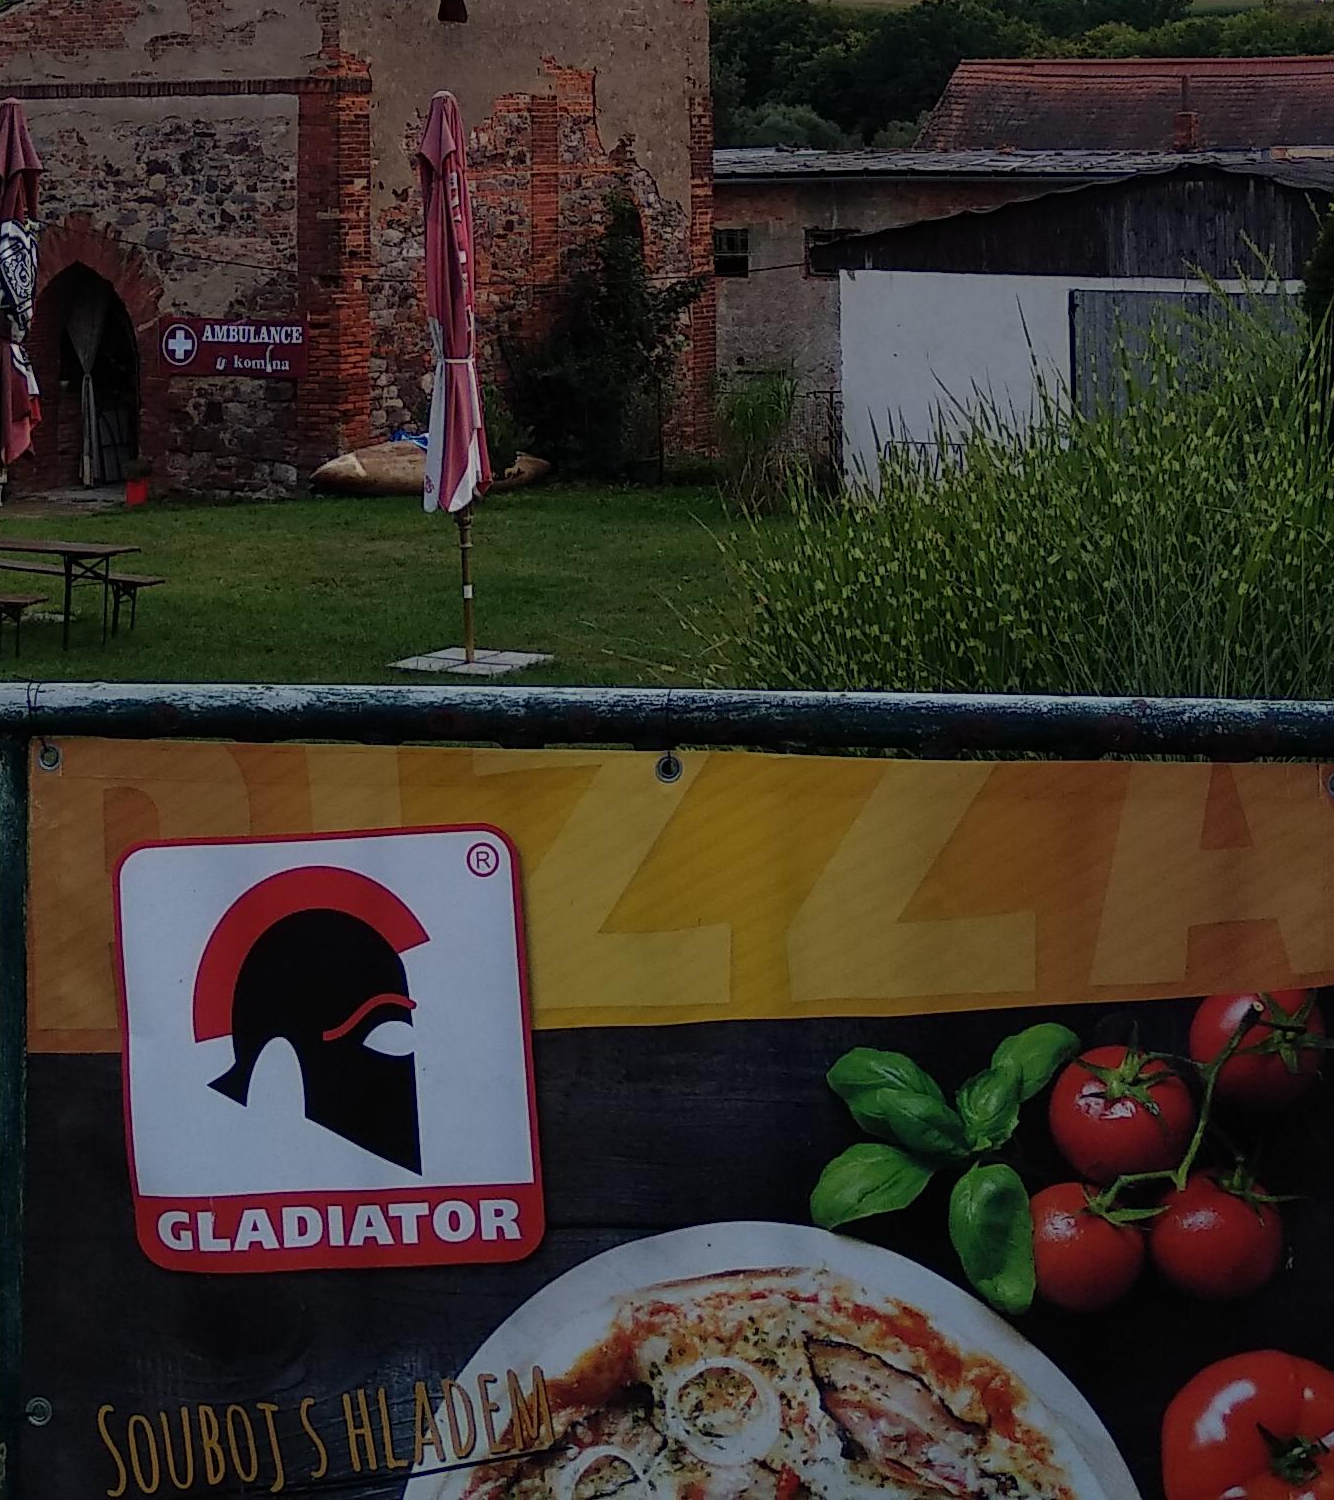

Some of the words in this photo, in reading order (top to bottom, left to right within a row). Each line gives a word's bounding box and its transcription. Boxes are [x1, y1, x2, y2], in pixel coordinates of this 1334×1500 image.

[201, 324, 303, 344] AMBULANCE
[156, 1199, 523, 1253] GLADIATOR
[97, 1403, 286, 1498] SOUBOJ
[299, 1397, 328, 1479] S
[342, 1365, 557, 1473] HLADEM
